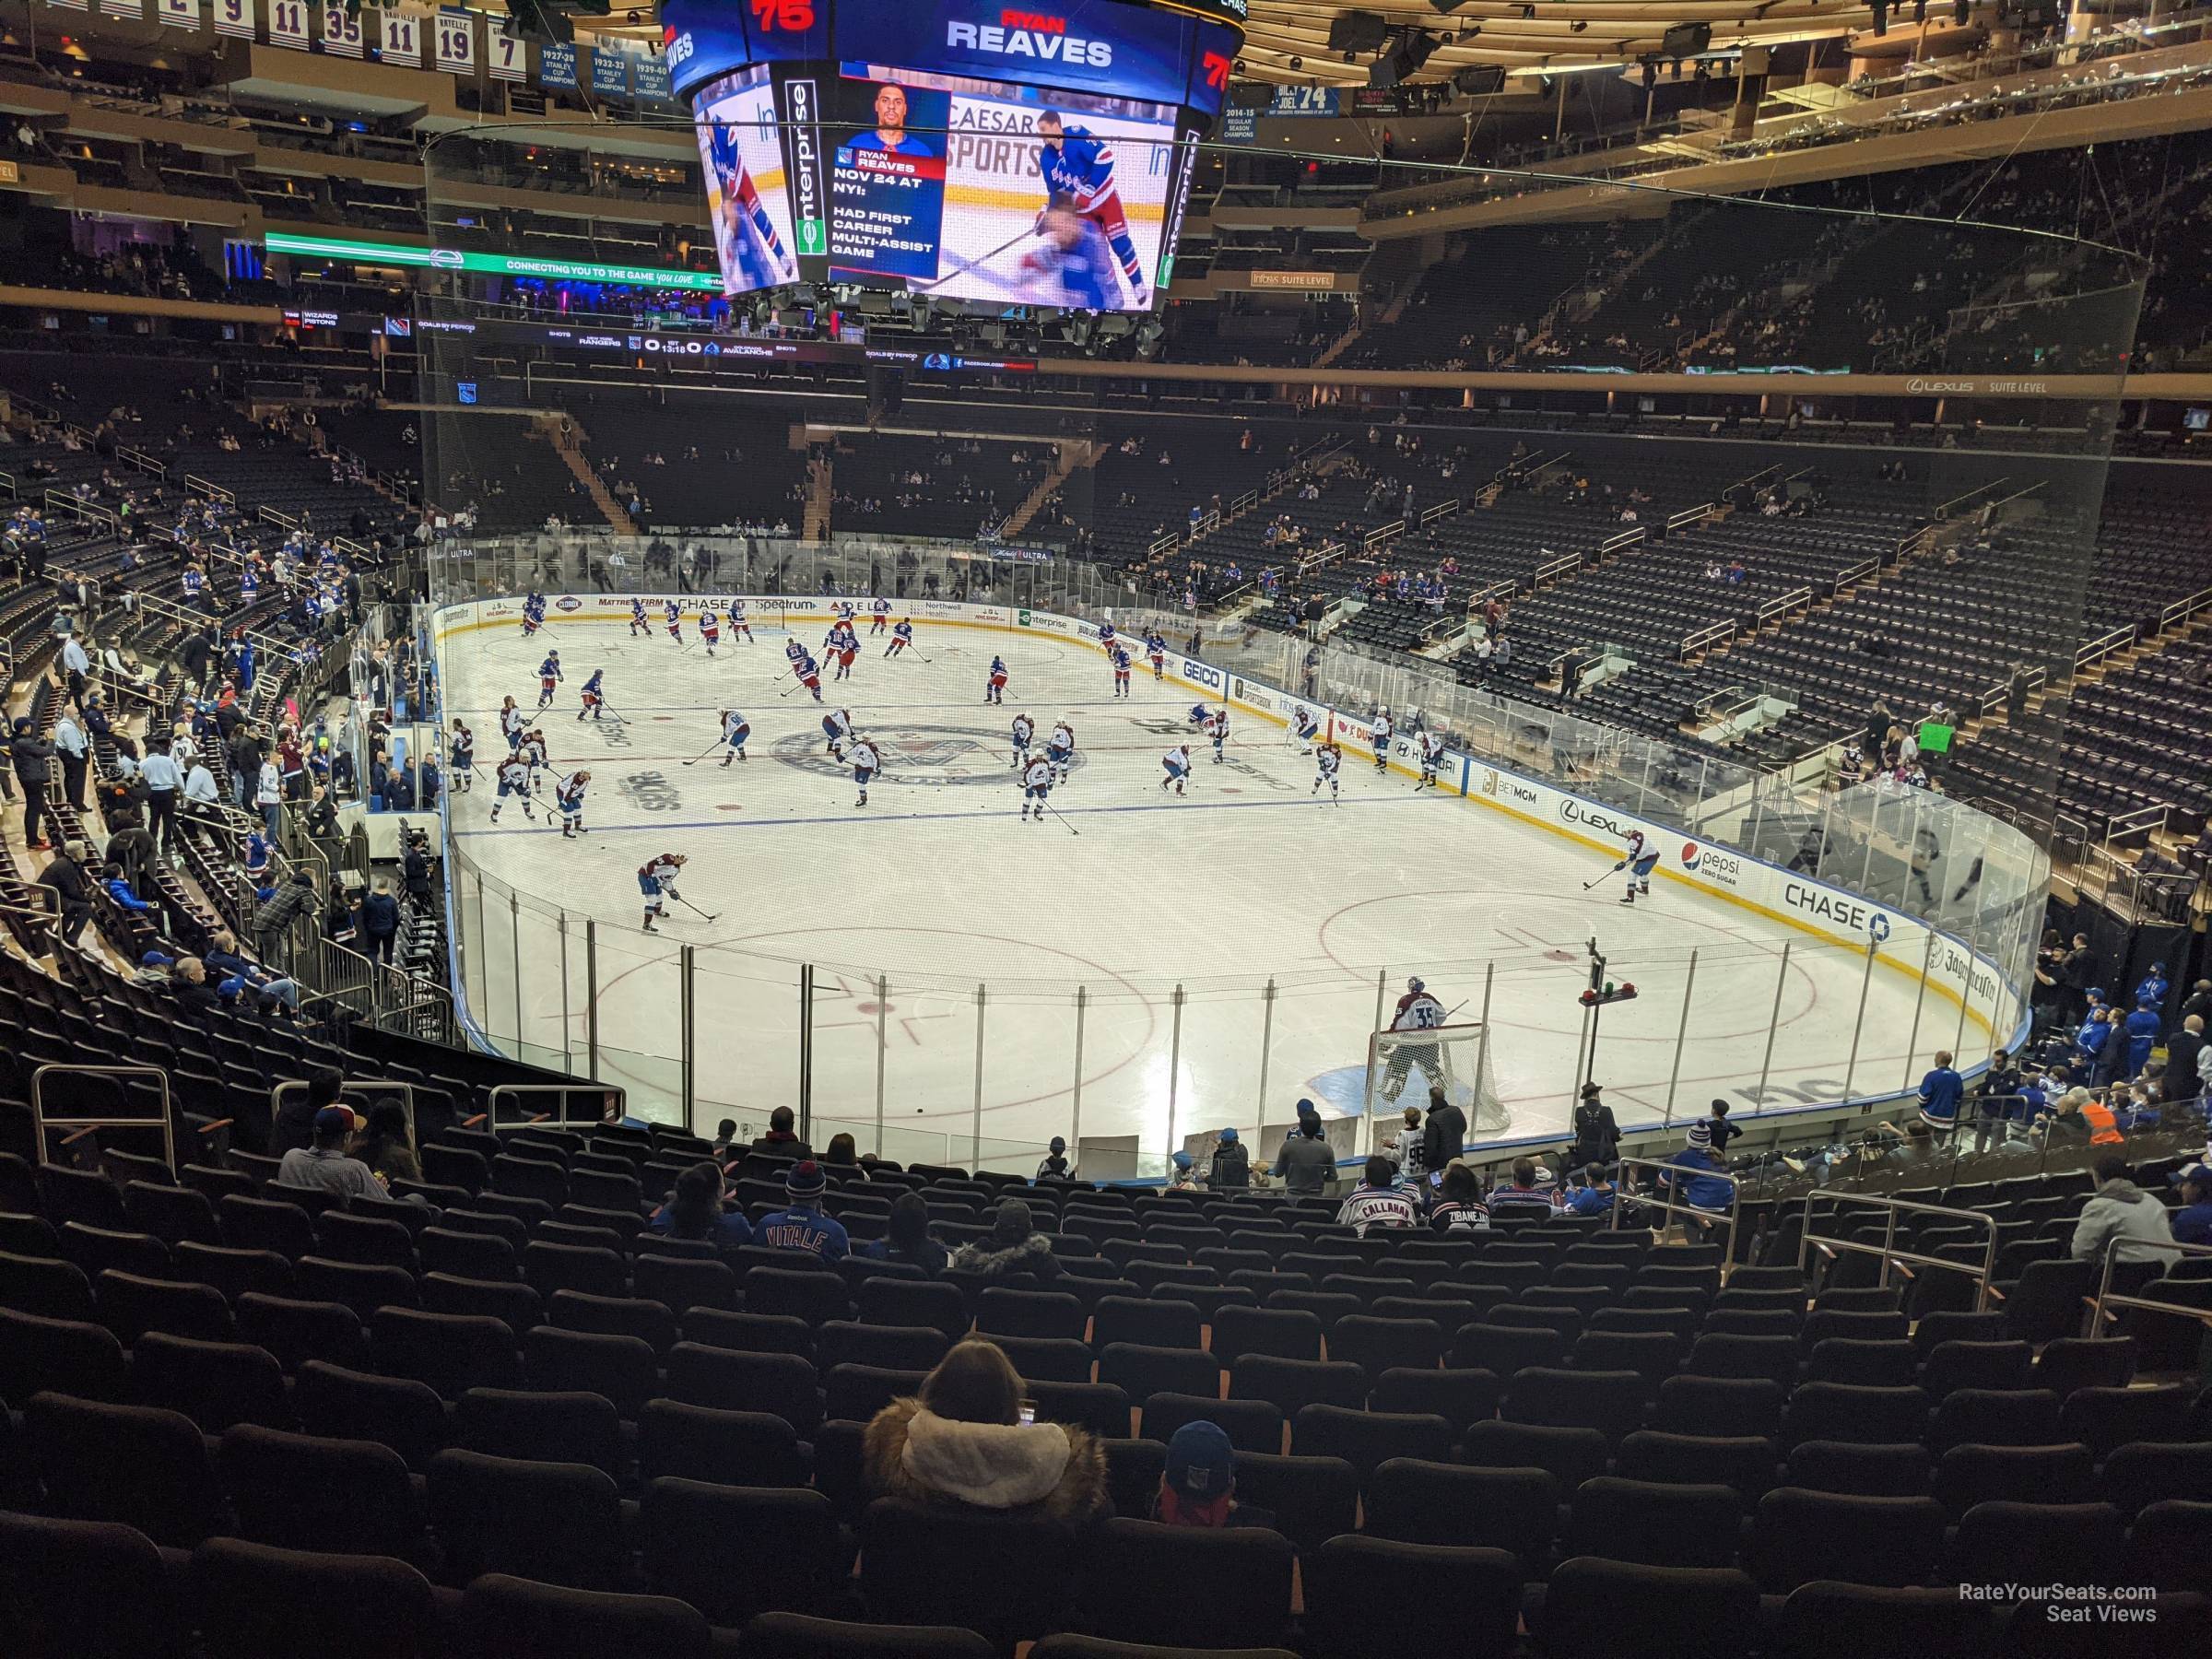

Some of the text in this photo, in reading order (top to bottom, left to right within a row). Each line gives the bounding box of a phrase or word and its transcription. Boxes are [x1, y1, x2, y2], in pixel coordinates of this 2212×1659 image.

[276, 2, 301, 34] 11
[751, 0, 814, 32] 75
[1001, 9, 1065, 33] RYAN
[326, 10, 359, 42] 35
[388, 21, 413, 53] 11
[947, 20, 1112, 67] REAVES
[441, 29, 468, 60] 19
[500, 38, 514, 66] 7
[542, 50, 575, 62] 1927-28
[546, 61, 571, 70] STANLEY
[594, 57, 625, 70] 1932-33
[636, 64, 667, 76] 1939-40
[596, 69, 621, 77] STANLEY
[1203, 52, 1228, 91] 7
[542, 75, 576, 85] CHAMPIONS
[639, 75, 664, 84] STANLEY
[593, 82, 625, 92] CHAMPIONS
[635, 88, 668, 98] CHAMPIONS
[1278, 85, 1298, 97] BILLY
[1278, 96, 1297, 110] JOEL
[1300, 86, 1327, 110] 74
[949, 103, 1039, 134] CAESAR
[1226, 109, 1254, 118] 2014-15
[859, 149, 888, 161] RYAN
[857, 159, 915, 173] REAVES
[834, 168, 923, 189] NOV 24 AT
[833, 182, 866, 196] NYI:
[833, 206, 912, 225] HAD FIRST
[832, 219, 893, 236] CAREER
[831, 232, 934, 253] MULTI-ASSIST
[831, 245, 875, 259] GAME
[506, 260, 571, 275] CONNECTING
[571, 265, 592, 276] YOU
[593, 268, 606, 277] TO
[606, 269, 627, 279] THE
[627, 271, 655, 281] GAME
[674, 274, 694, 284] LOVE
[1282, 276, 1305, 285] SUITE
[1306, 276, 1331, 286] LEVEL
[304, 312, 338, 320] WIZARDS
[304, 318, 336, 326] PISTONS
[579, 338, 621, 347] RANGERS
[644, 339, 661, 351] 0
[687, 342, 702, 354] 0
[662, 346, 686, 355] 13:18
[723, 347, 773, 357] AVALANCHE
[1924, 382, 2047, 394] LEXUS SUITE LEVEL
[451, 549, 473, 559] ULTRA
[1022, 552, 1048, 560] ULTRA
[641, 598, 665, 606] FIRM
[678, 598, 730, 610] CHASE
[925, 602, 961, 611] Northwell
[1022, 612, 1067, 629] enterprise
[1183, 661, 1220, 689] GEICO
[1498, 780, 1537, 805] BETMGM
[1701, 851, 1740, 875] pepsi
[1701, 868, 1736, 886] ZERO SUGAR
[1784, 883, 1865, 931] CHASE
[1416, 1006, 1434, 1029] 35
[766, 1224, 829, 1253] VITALE
